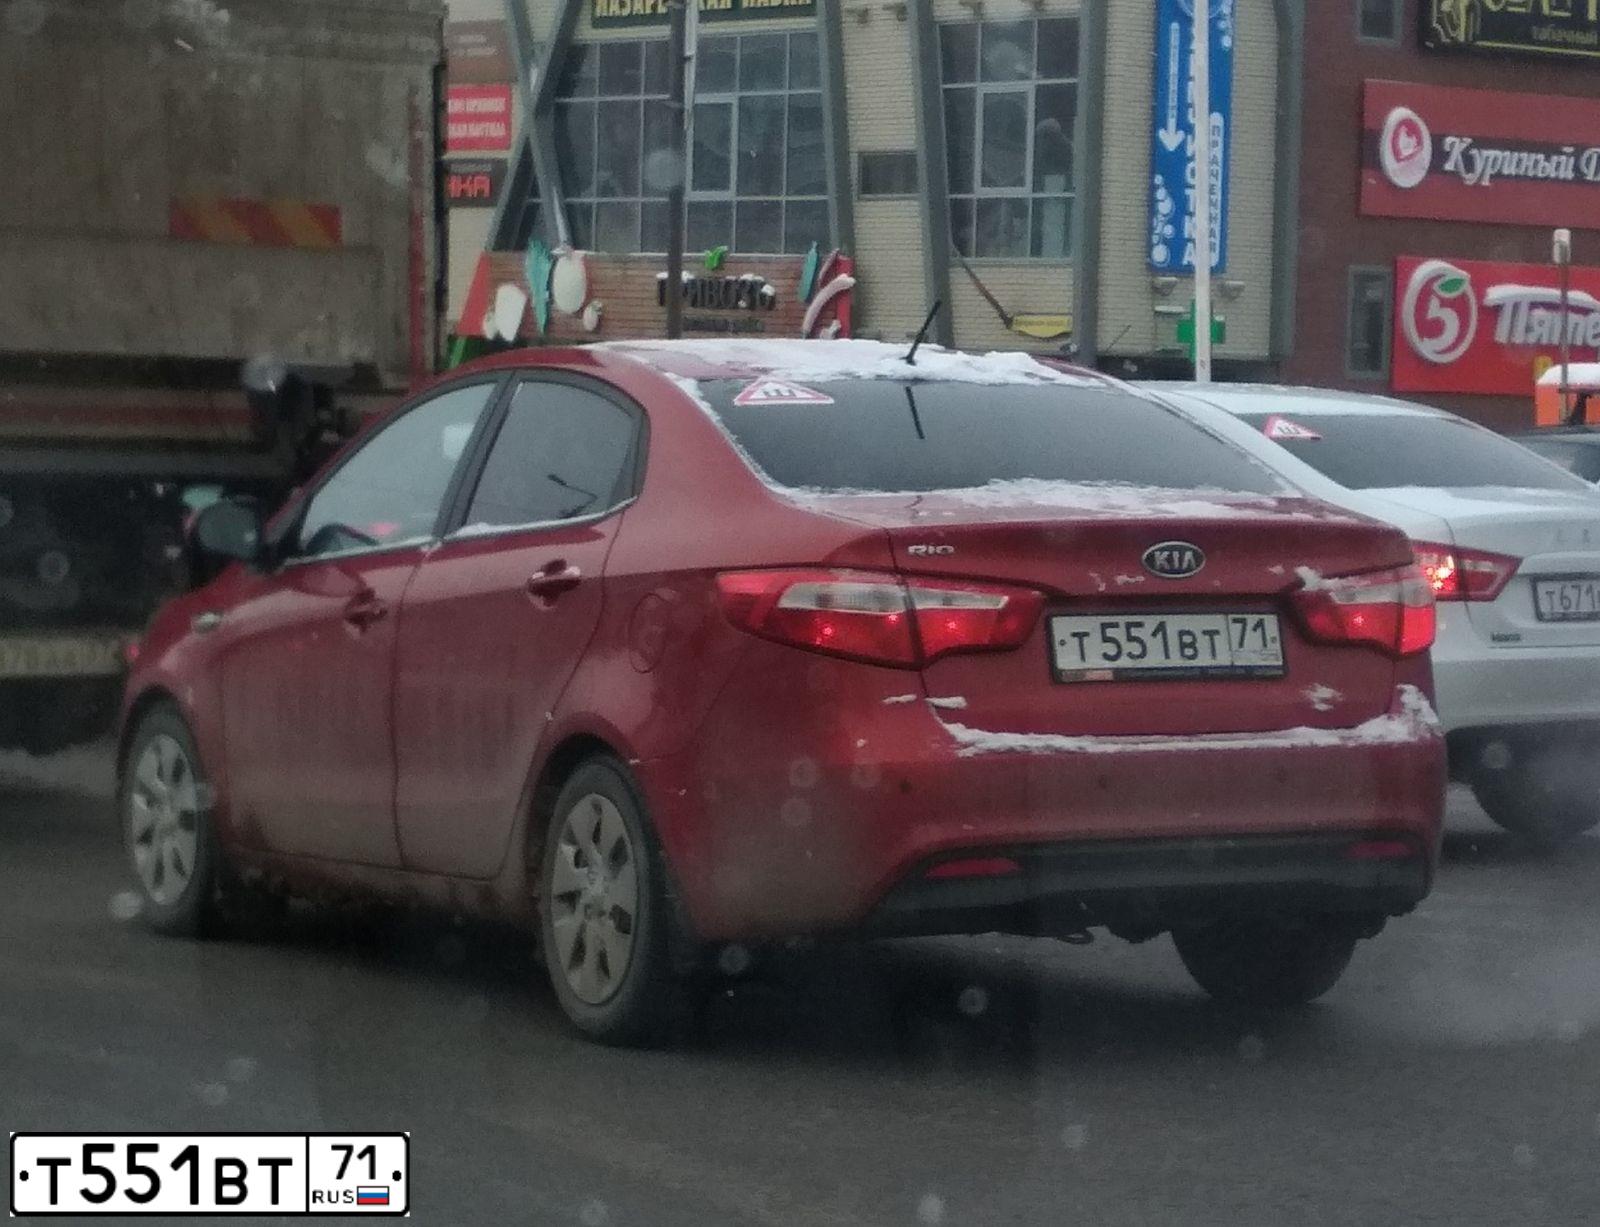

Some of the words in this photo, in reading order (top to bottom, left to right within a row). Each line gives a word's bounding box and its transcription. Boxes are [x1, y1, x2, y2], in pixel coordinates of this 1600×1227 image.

[1443, 135, 1575, 186] Куриный
[907, 545, 955, 556] RIO
[1153, 550, 1197, 570] KIA
[1071, 620, 1221, 663] Т551ВТ
[1231, 617, 1269, 649] 71
